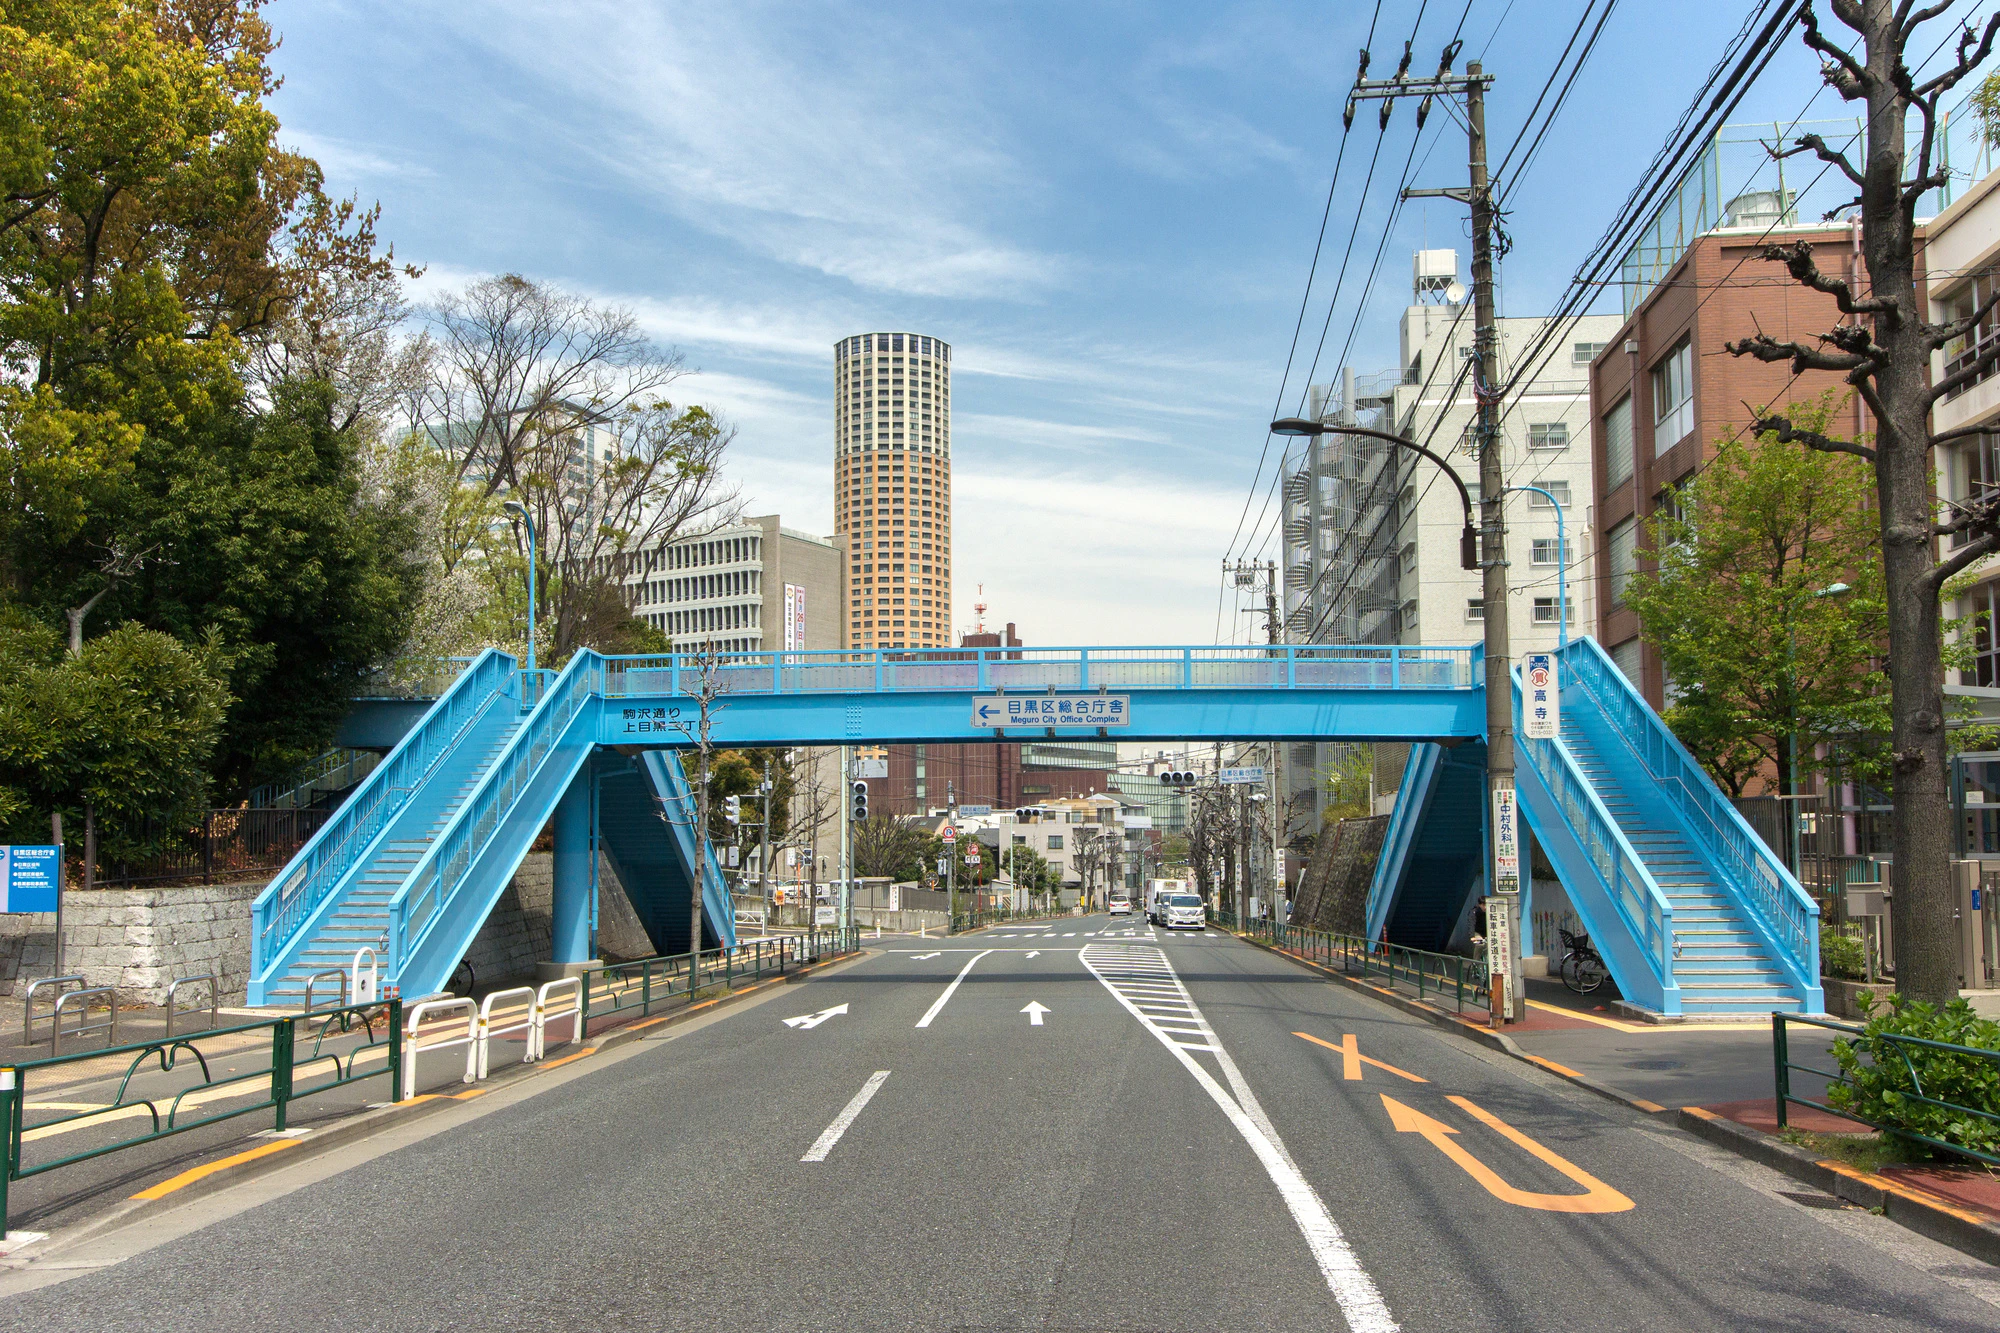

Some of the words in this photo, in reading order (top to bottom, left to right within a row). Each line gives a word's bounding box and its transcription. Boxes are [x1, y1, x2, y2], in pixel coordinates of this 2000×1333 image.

[1008, 700, 1123, 714] 目黒区総合庁舎
[1534, 689, 1547, 719] 高寺
[623, 707, 680, 719] 駒沢通り
[1011, 716, 1039, 724] Meguro
[1042, 715, 1057, 724] City
[1060, 715, 1083, 723] Office
[1086, 715, 1120, 724] Complex
[1500, 804, 1512, 843] 中村外科
